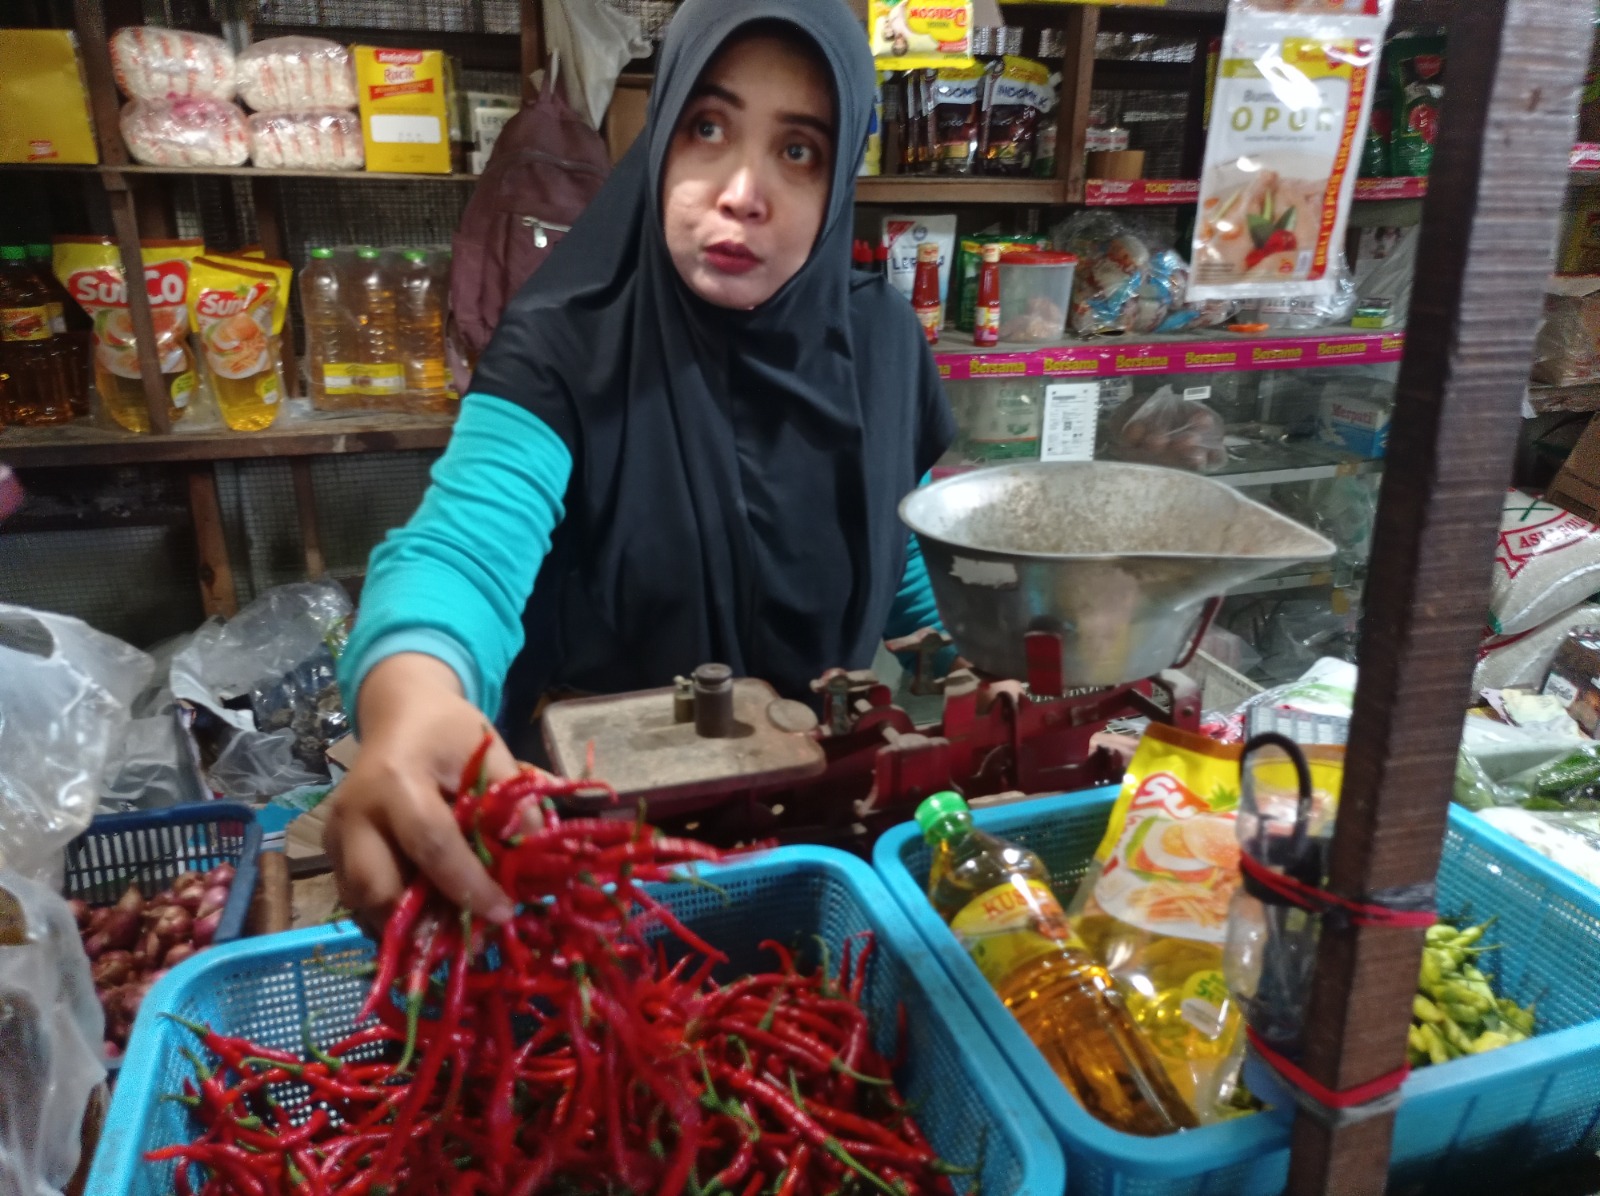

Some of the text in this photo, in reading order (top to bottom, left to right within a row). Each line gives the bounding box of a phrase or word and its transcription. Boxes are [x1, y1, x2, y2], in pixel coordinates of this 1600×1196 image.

[970, 360, 1027, 374] Bersama
[1043, 358, 1099, 372] Bersama
[1116, 355, 1169, 368] Bersama
[1185, 352, 1237, 365] Bersama
[1253, 347, 1302, 360] Bersama
[1318, 342, 1367, 356] Bersama
